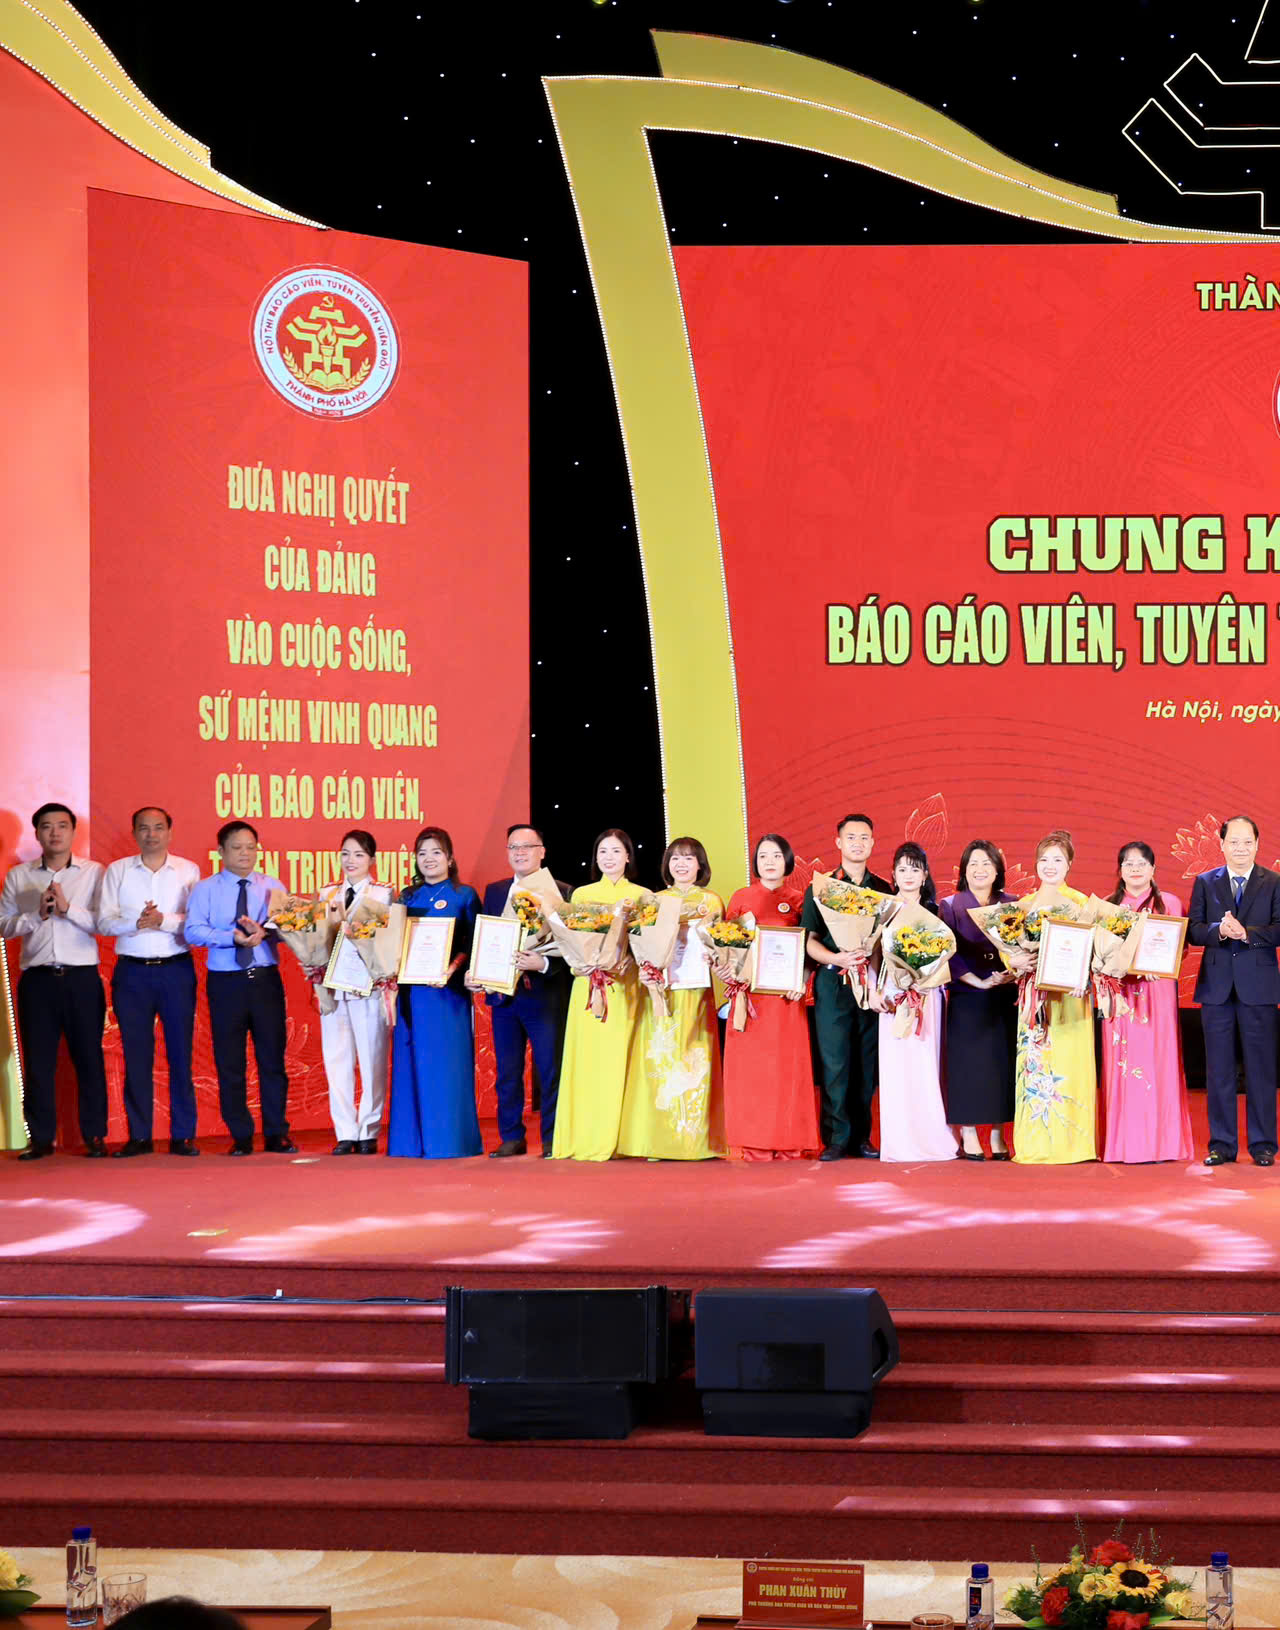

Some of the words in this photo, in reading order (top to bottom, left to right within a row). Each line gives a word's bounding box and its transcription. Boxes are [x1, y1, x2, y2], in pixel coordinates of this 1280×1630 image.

[227, 462, 275, 512] ĐƯA
[283, 471, 335, 527] NGHỊ
[343, 468, 409, 525] QUYẾT
[265, 537, 310, 591] CỦA
[317, 541, 376, 596] ĐẢNG
[989, 517, 1224, 571] CHUNG
[227, 614, 272, 665] VÀO
[280, 617, 341, 676] CUỘC
[349, 614, 411, 676] SỐNG,
[829, 596, 909, 664] BÁO
[926, 596, 1007, 664] CÁO
[1021, 595, 1123, 670] VIÊN,
[1137, 594, 1264, 663] TUYÊN
[199, 690, 232, 741] SỨ
[238, 692, 300, 750] MỆNH
[307, 701, 360, 746] VINH
[368, 703, 437, 750] QUANG
[1146, 700, 1176, 718] Hà
[1183, 700, 1222, 722] Nội,
[216, 763, 262, 818] CỦA
[270, 768, 314, 819] BÁO
[322, 770, 365, 819] CÁO
[372, 771, 424, 824] VIÊN,
[209, 842, 279, 880] TÊN
[759, 1584, 787, 1597] PHAN
[790, 1584, 817, 1598] XUÂN
